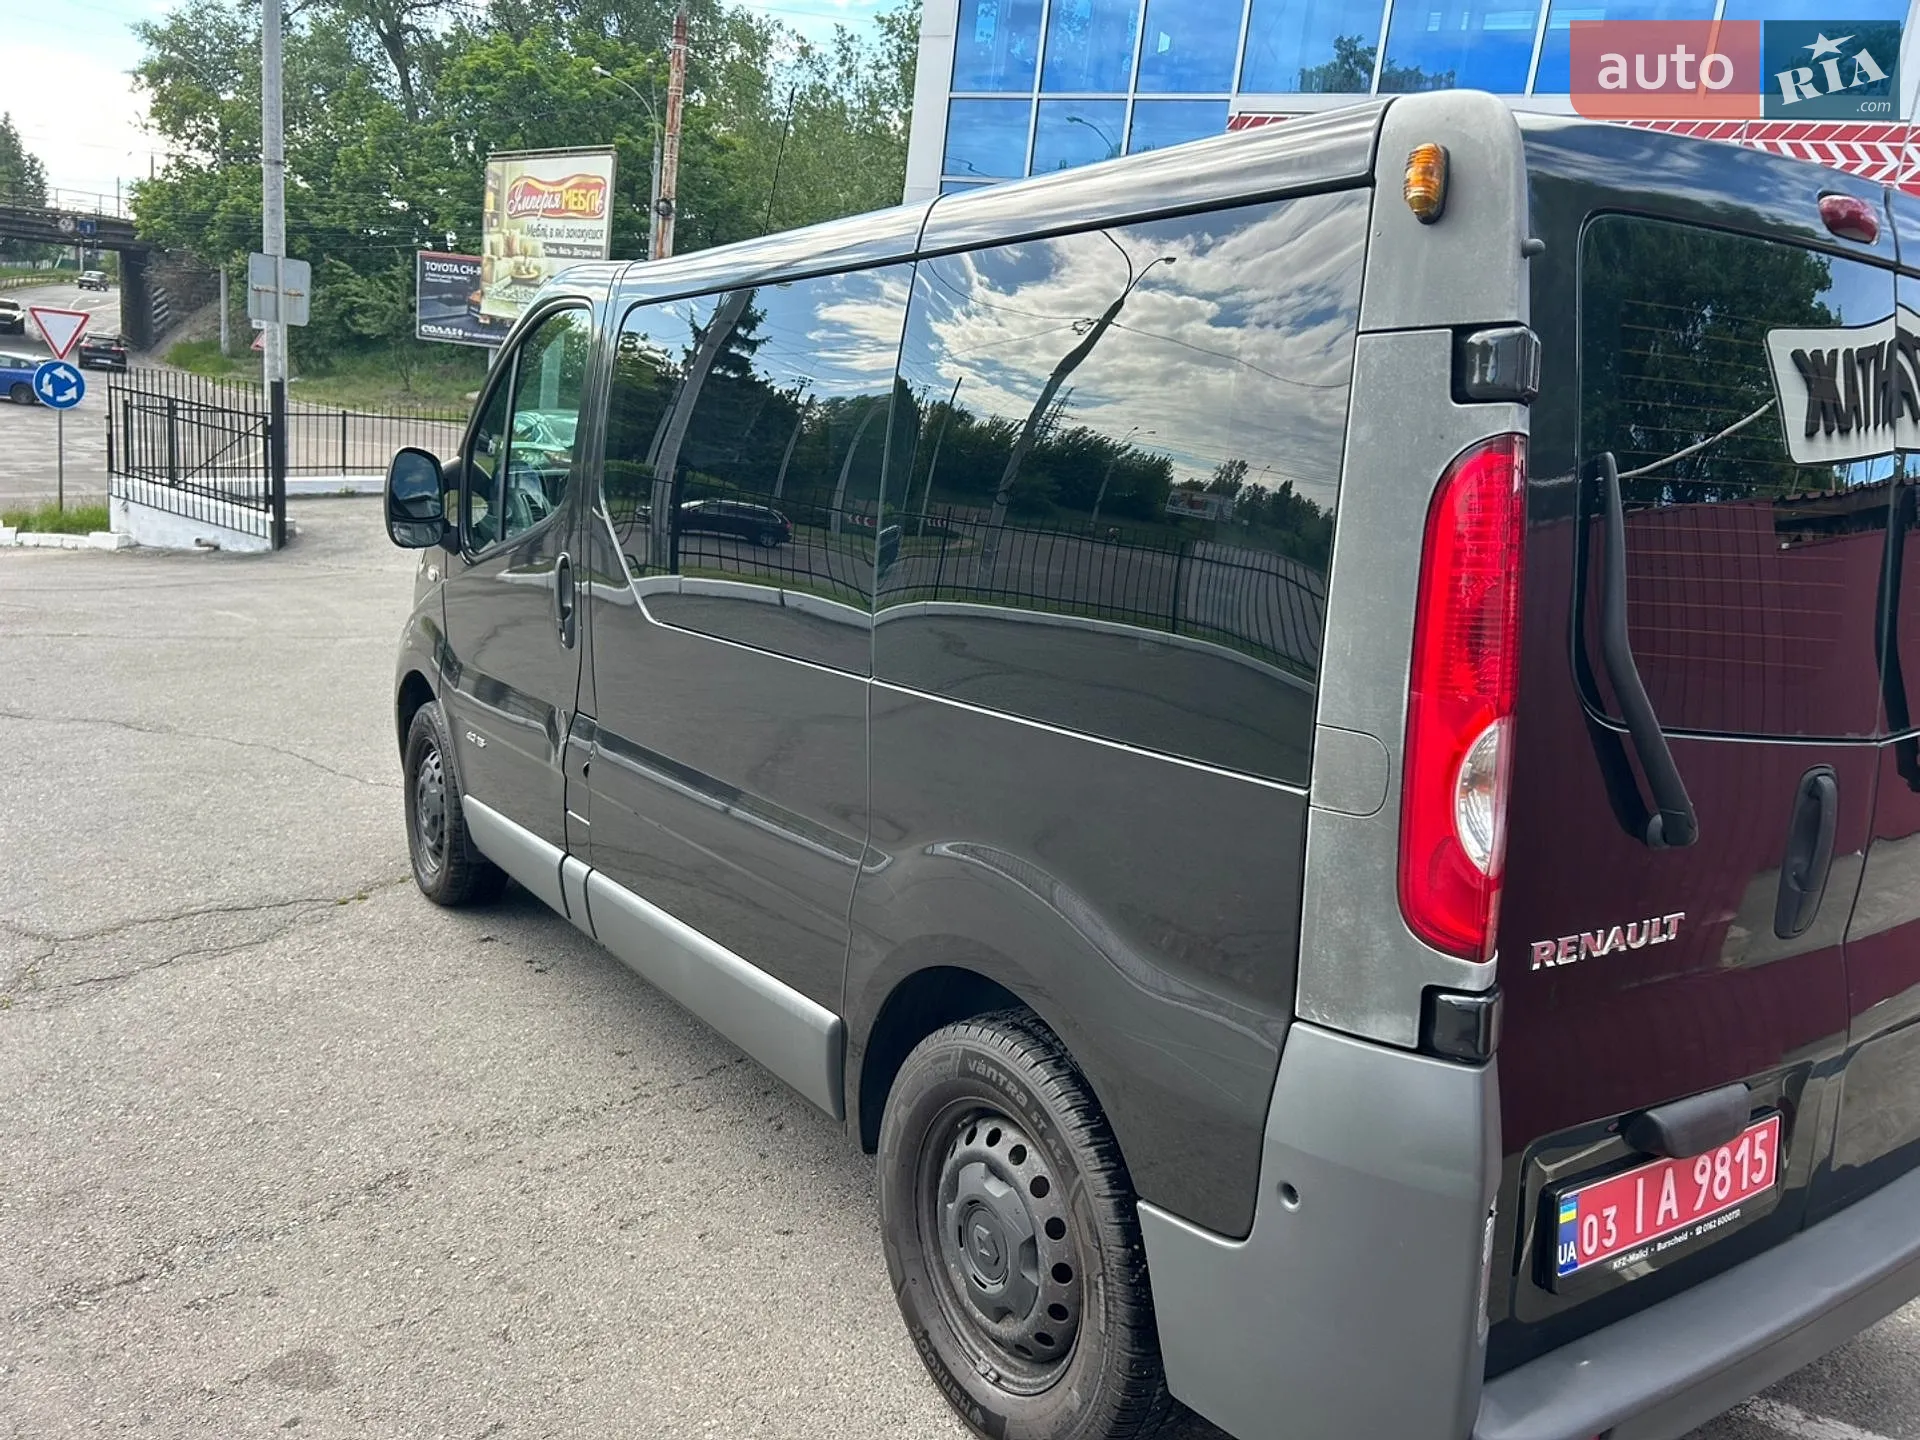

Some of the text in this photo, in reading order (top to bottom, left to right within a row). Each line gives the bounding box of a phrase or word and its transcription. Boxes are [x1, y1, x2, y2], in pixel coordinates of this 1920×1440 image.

[425, 261, 460, 273] TOYOTA
[1530, 911, 1686, 971] RENAULT
[1582, 1130, 1768, 1256] 03 IA 9815
[1558, 1241, 1577, 1265] UA
